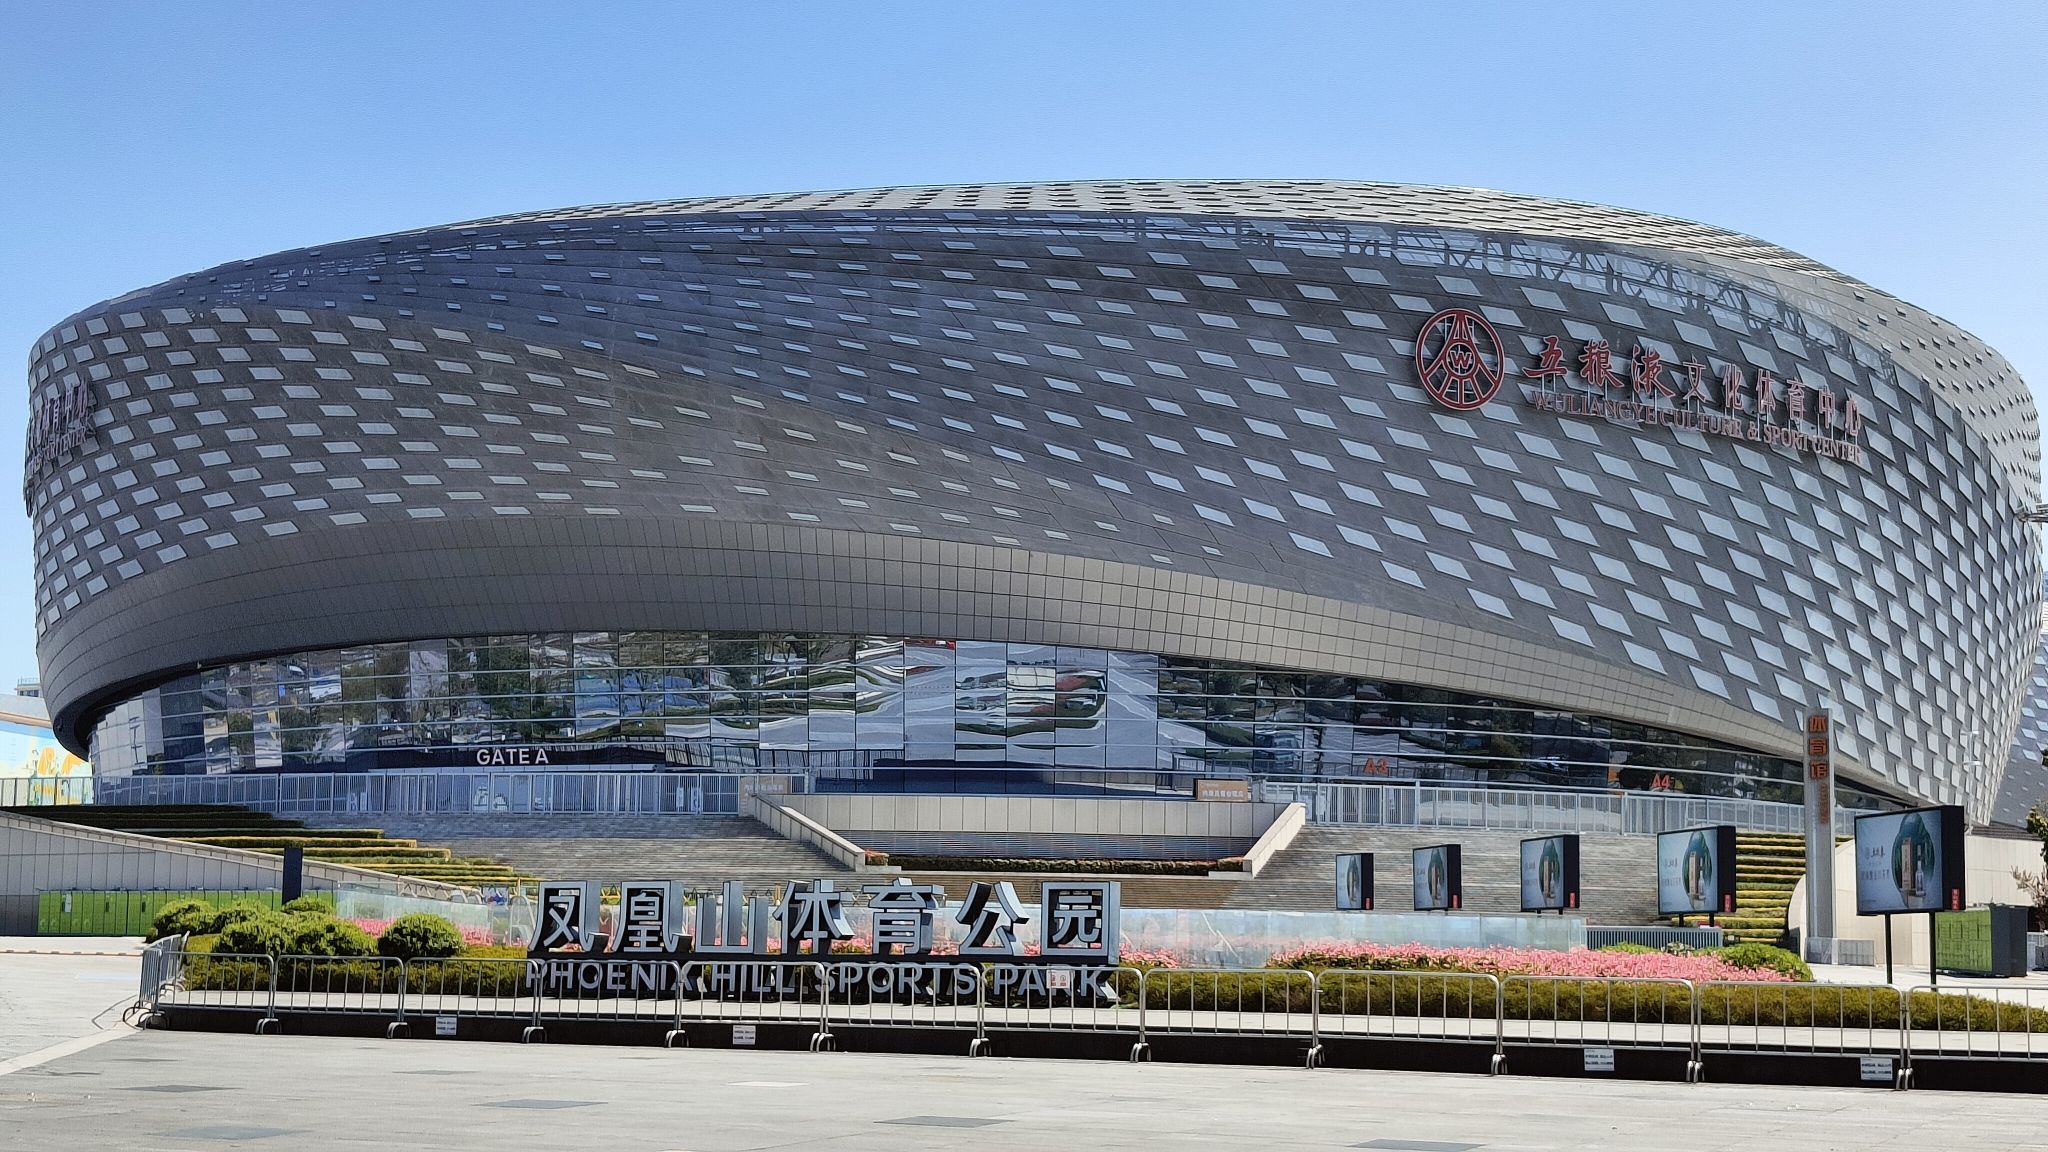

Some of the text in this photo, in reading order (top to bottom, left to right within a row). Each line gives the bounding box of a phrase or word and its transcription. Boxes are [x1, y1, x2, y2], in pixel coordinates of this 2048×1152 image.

[1522, 335, 1861, 436] 五粮液文化体育中心
[1531, 391, 1657, 424] WULIANGYE
[1659, 407, 1744, 440] CULTURE
[1747, 420, 1761, 442] &
[1810, 434, 1863, 465] CENTER
[476, 748, 549, 765] GATE A
[1363, 756, 1388, 774] A3
[1650, 773, 1671, 789] A4
[528, 878, 1118, 957] 凤凰山体育公园
[525, 958, 693, 992] PHOENIX
[711, 961, 796, 994] HILL
[814, 961, 977, 996] SPORTS
